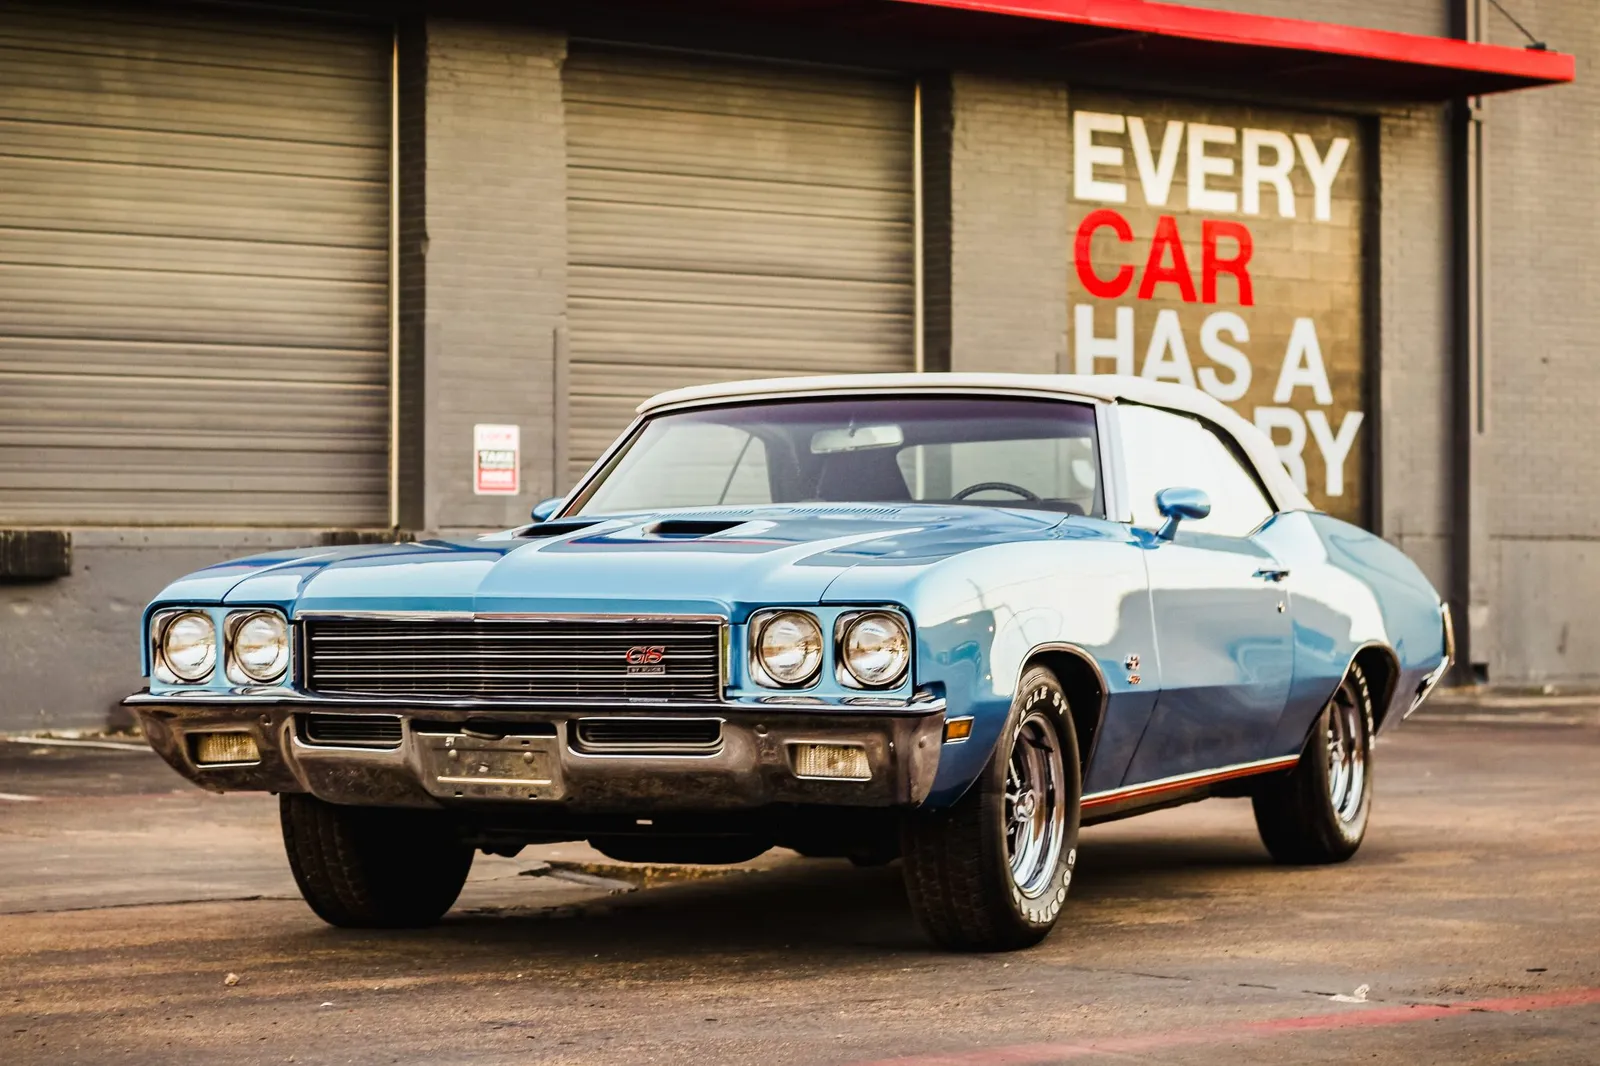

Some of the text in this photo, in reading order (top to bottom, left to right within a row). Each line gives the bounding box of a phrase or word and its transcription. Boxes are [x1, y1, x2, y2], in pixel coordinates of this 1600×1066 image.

[1073, 110, 1350, 221] EVERY
[1073, 208, 1255, 306] CAR
[1074, 304, 1333, 405] HAS A
[625, 645, 666, 664] GS
